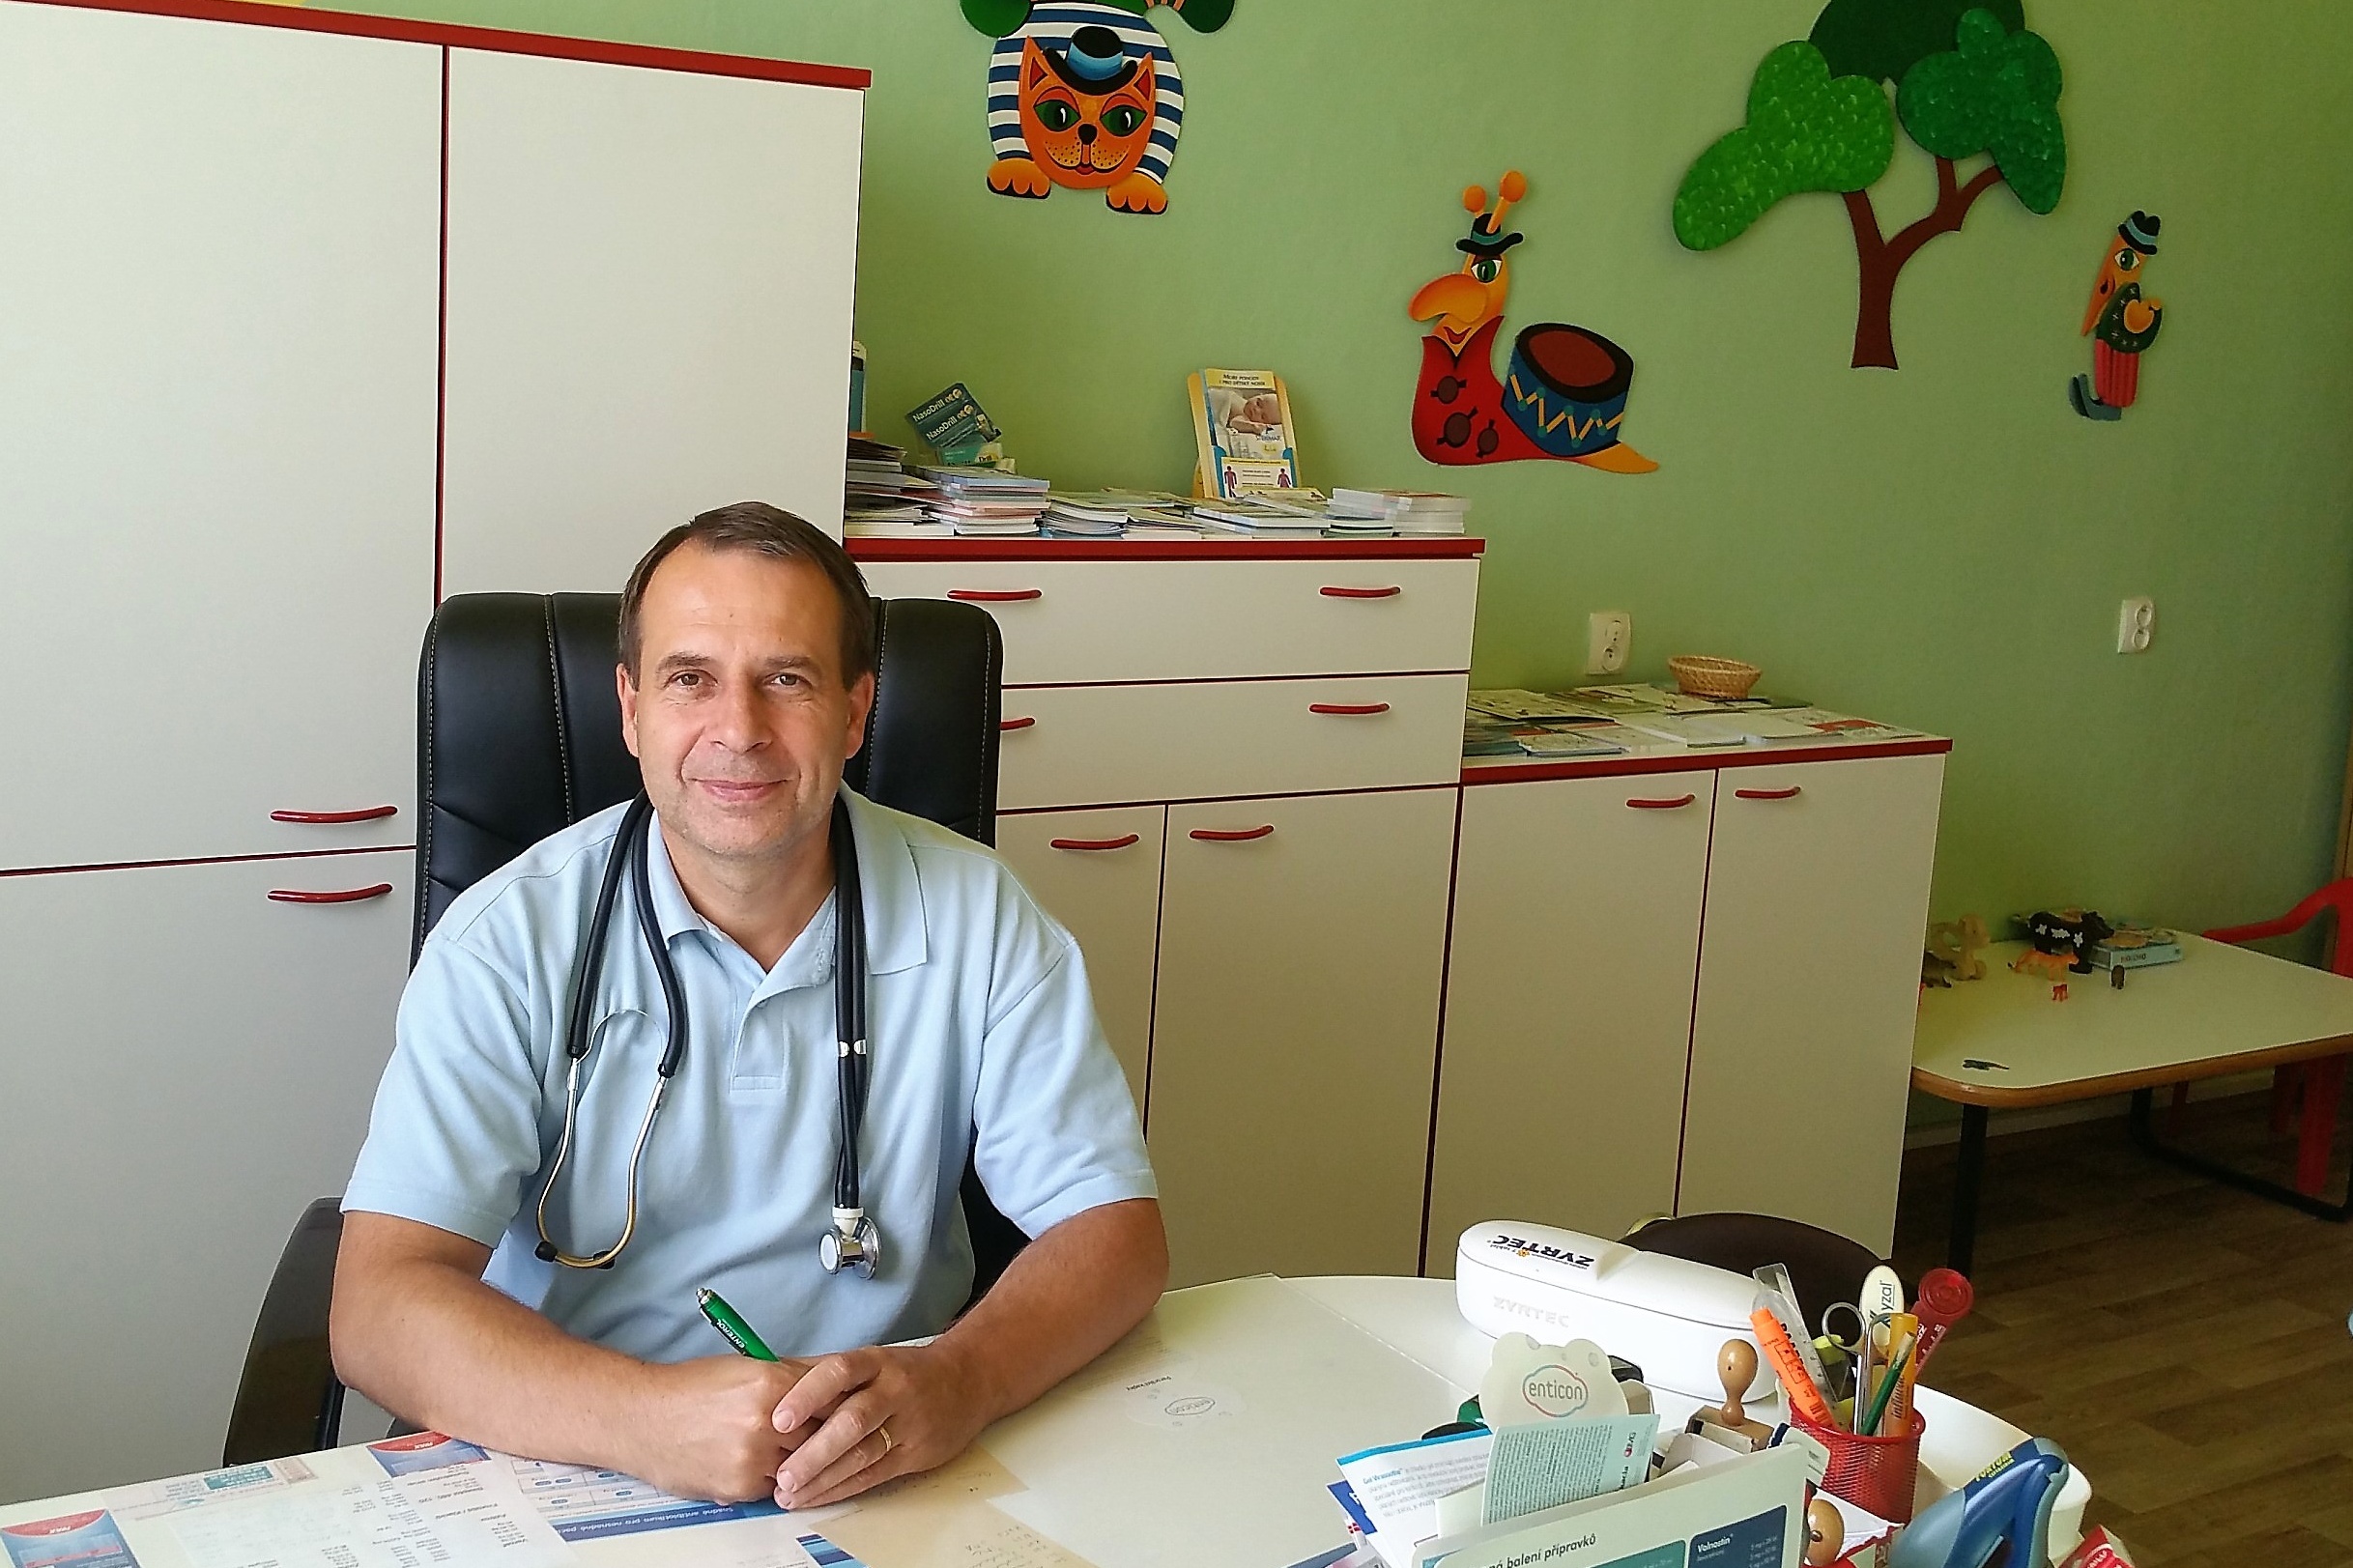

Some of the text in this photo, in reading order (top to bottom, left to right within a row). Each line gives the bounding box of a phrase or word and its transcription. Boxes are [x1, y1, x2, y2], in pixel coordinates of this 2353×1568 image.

[912, 399, 945, 422] NasoDrill
[926, 415, 958, 441] NasoDrill
[1492, 1235, 1595, 1268] ZYRTEC
[1528, 1379, 1583, 1401] enticon
[1506, 1533, 1596, 1568] balení přípravků
